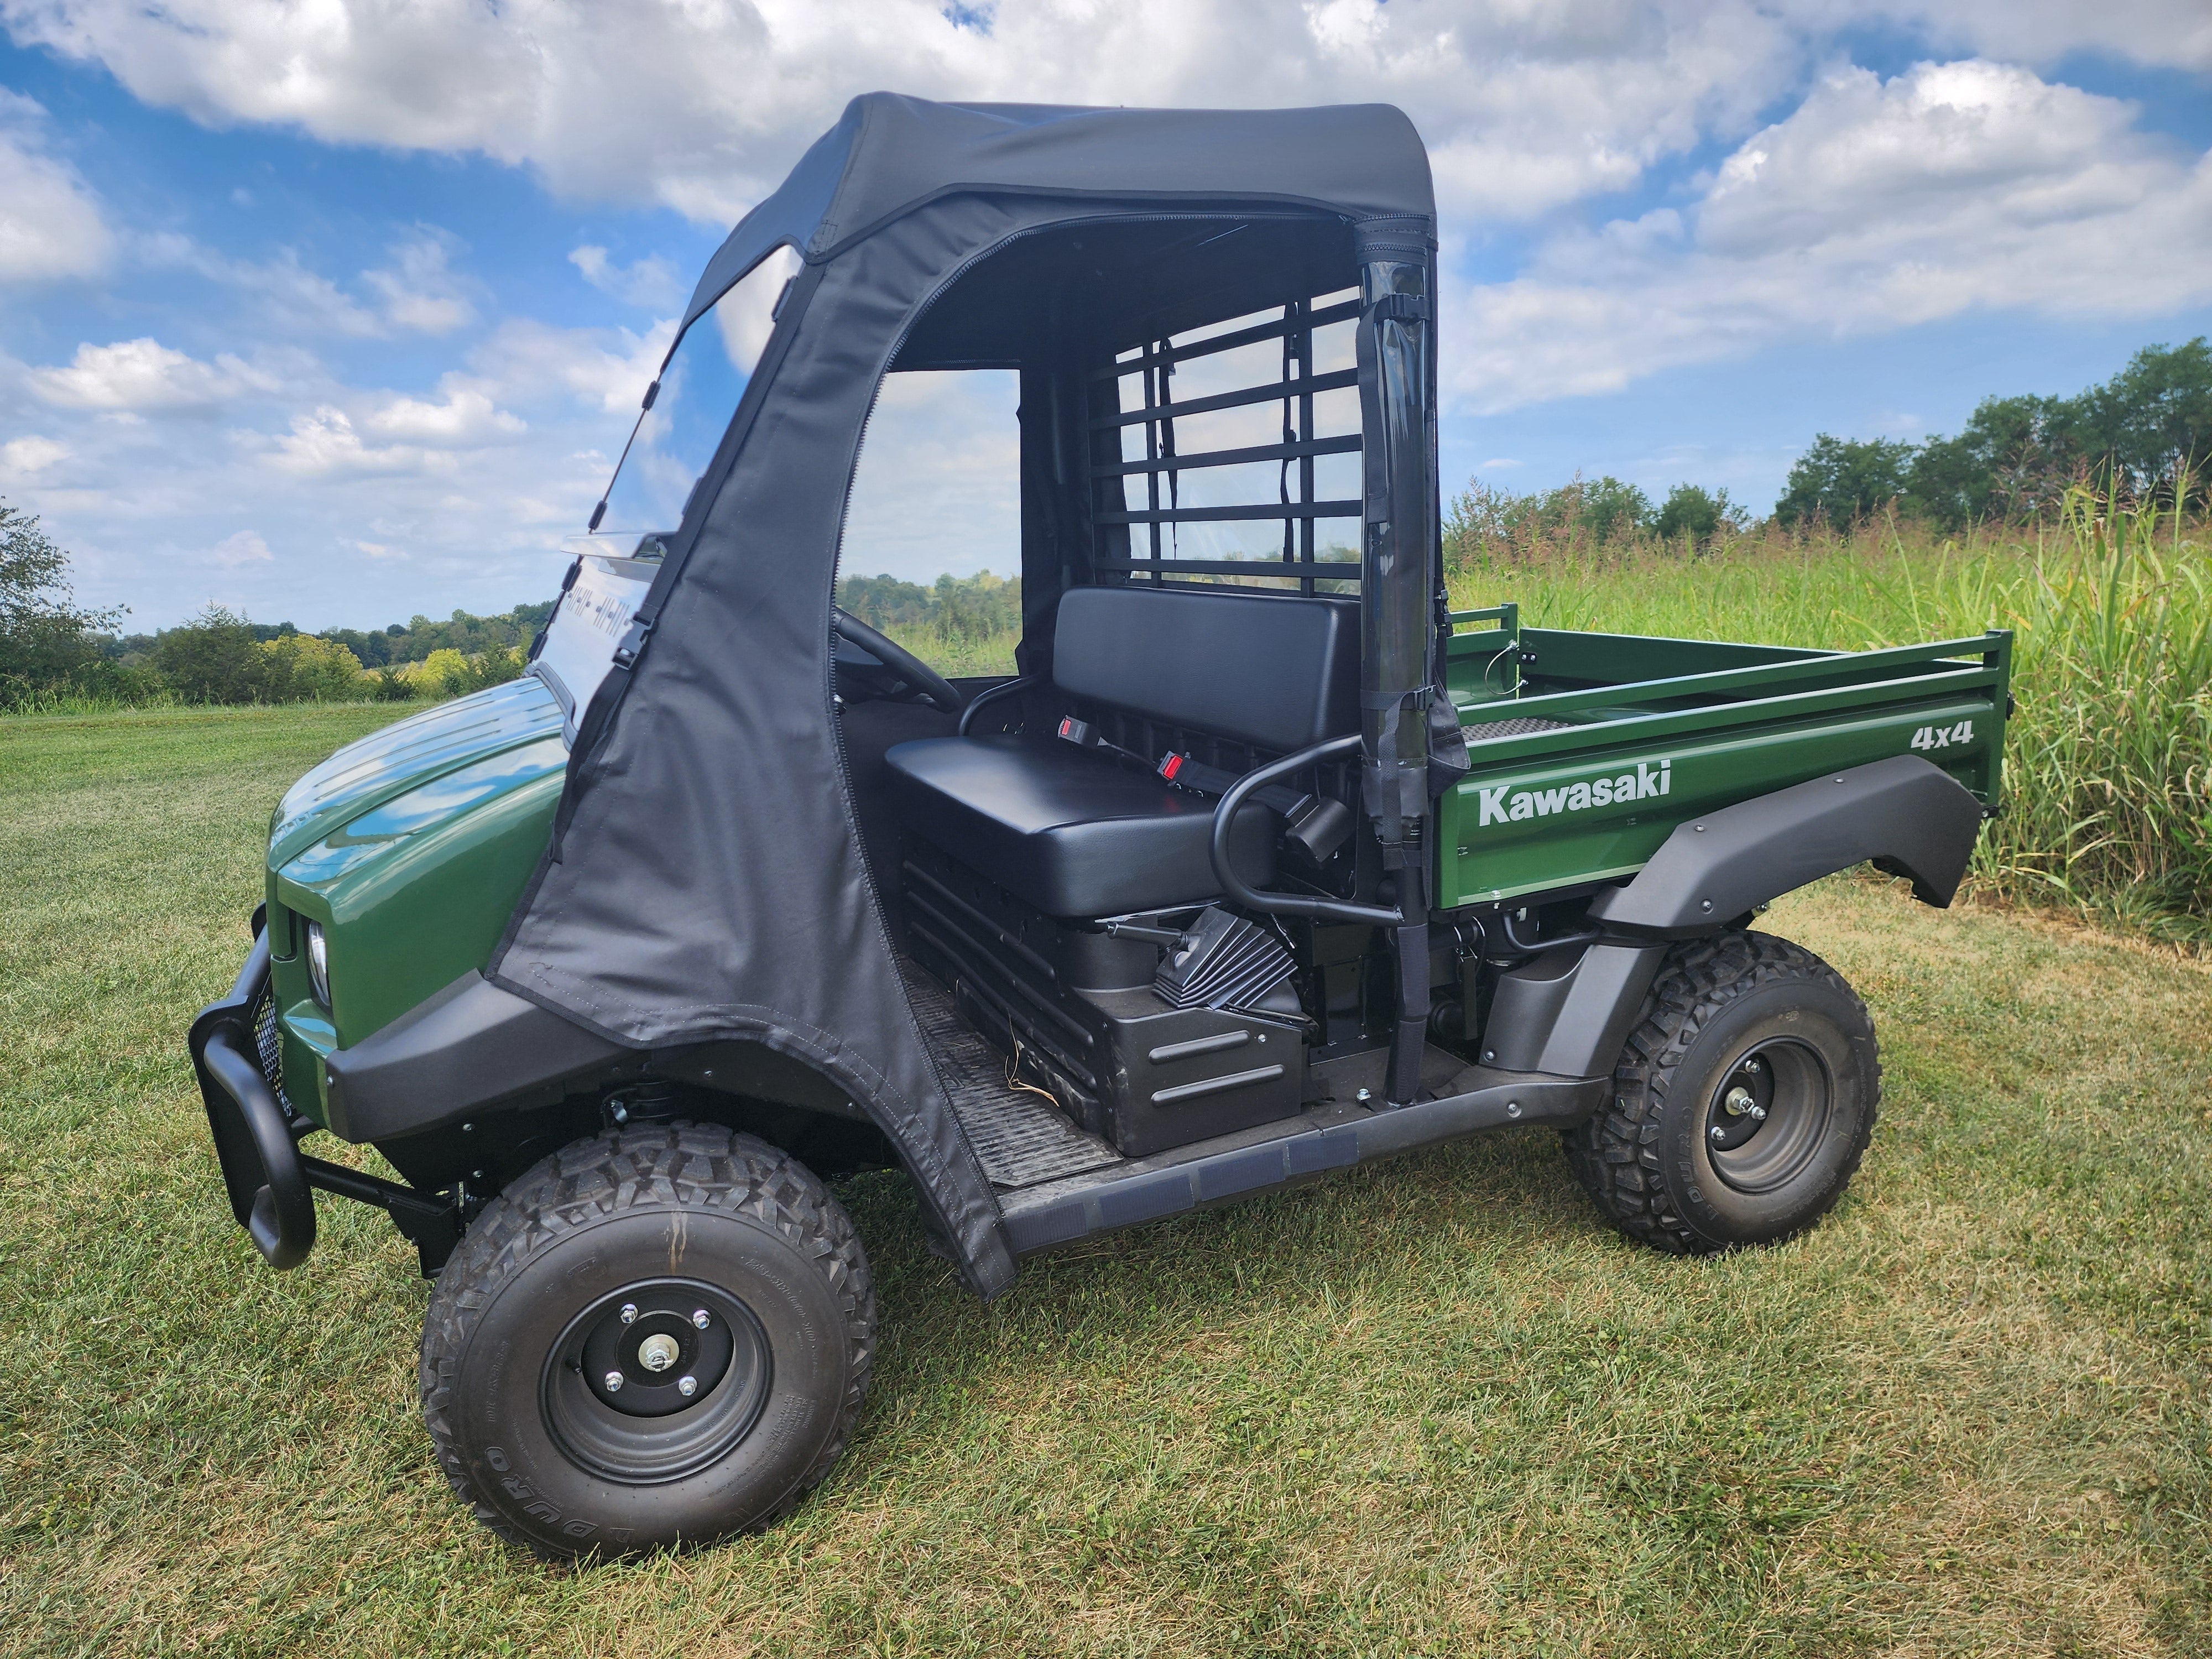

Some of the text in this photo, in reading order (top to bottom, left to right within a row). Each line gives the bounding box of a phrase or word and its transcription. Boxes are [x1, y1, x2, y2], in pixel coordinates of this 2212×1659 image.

[1911, 720, 1974, 750] 4x4
[1479, 759, 1671, 827] Kawasaki
[484, 1446, 598, 1538] DURO
